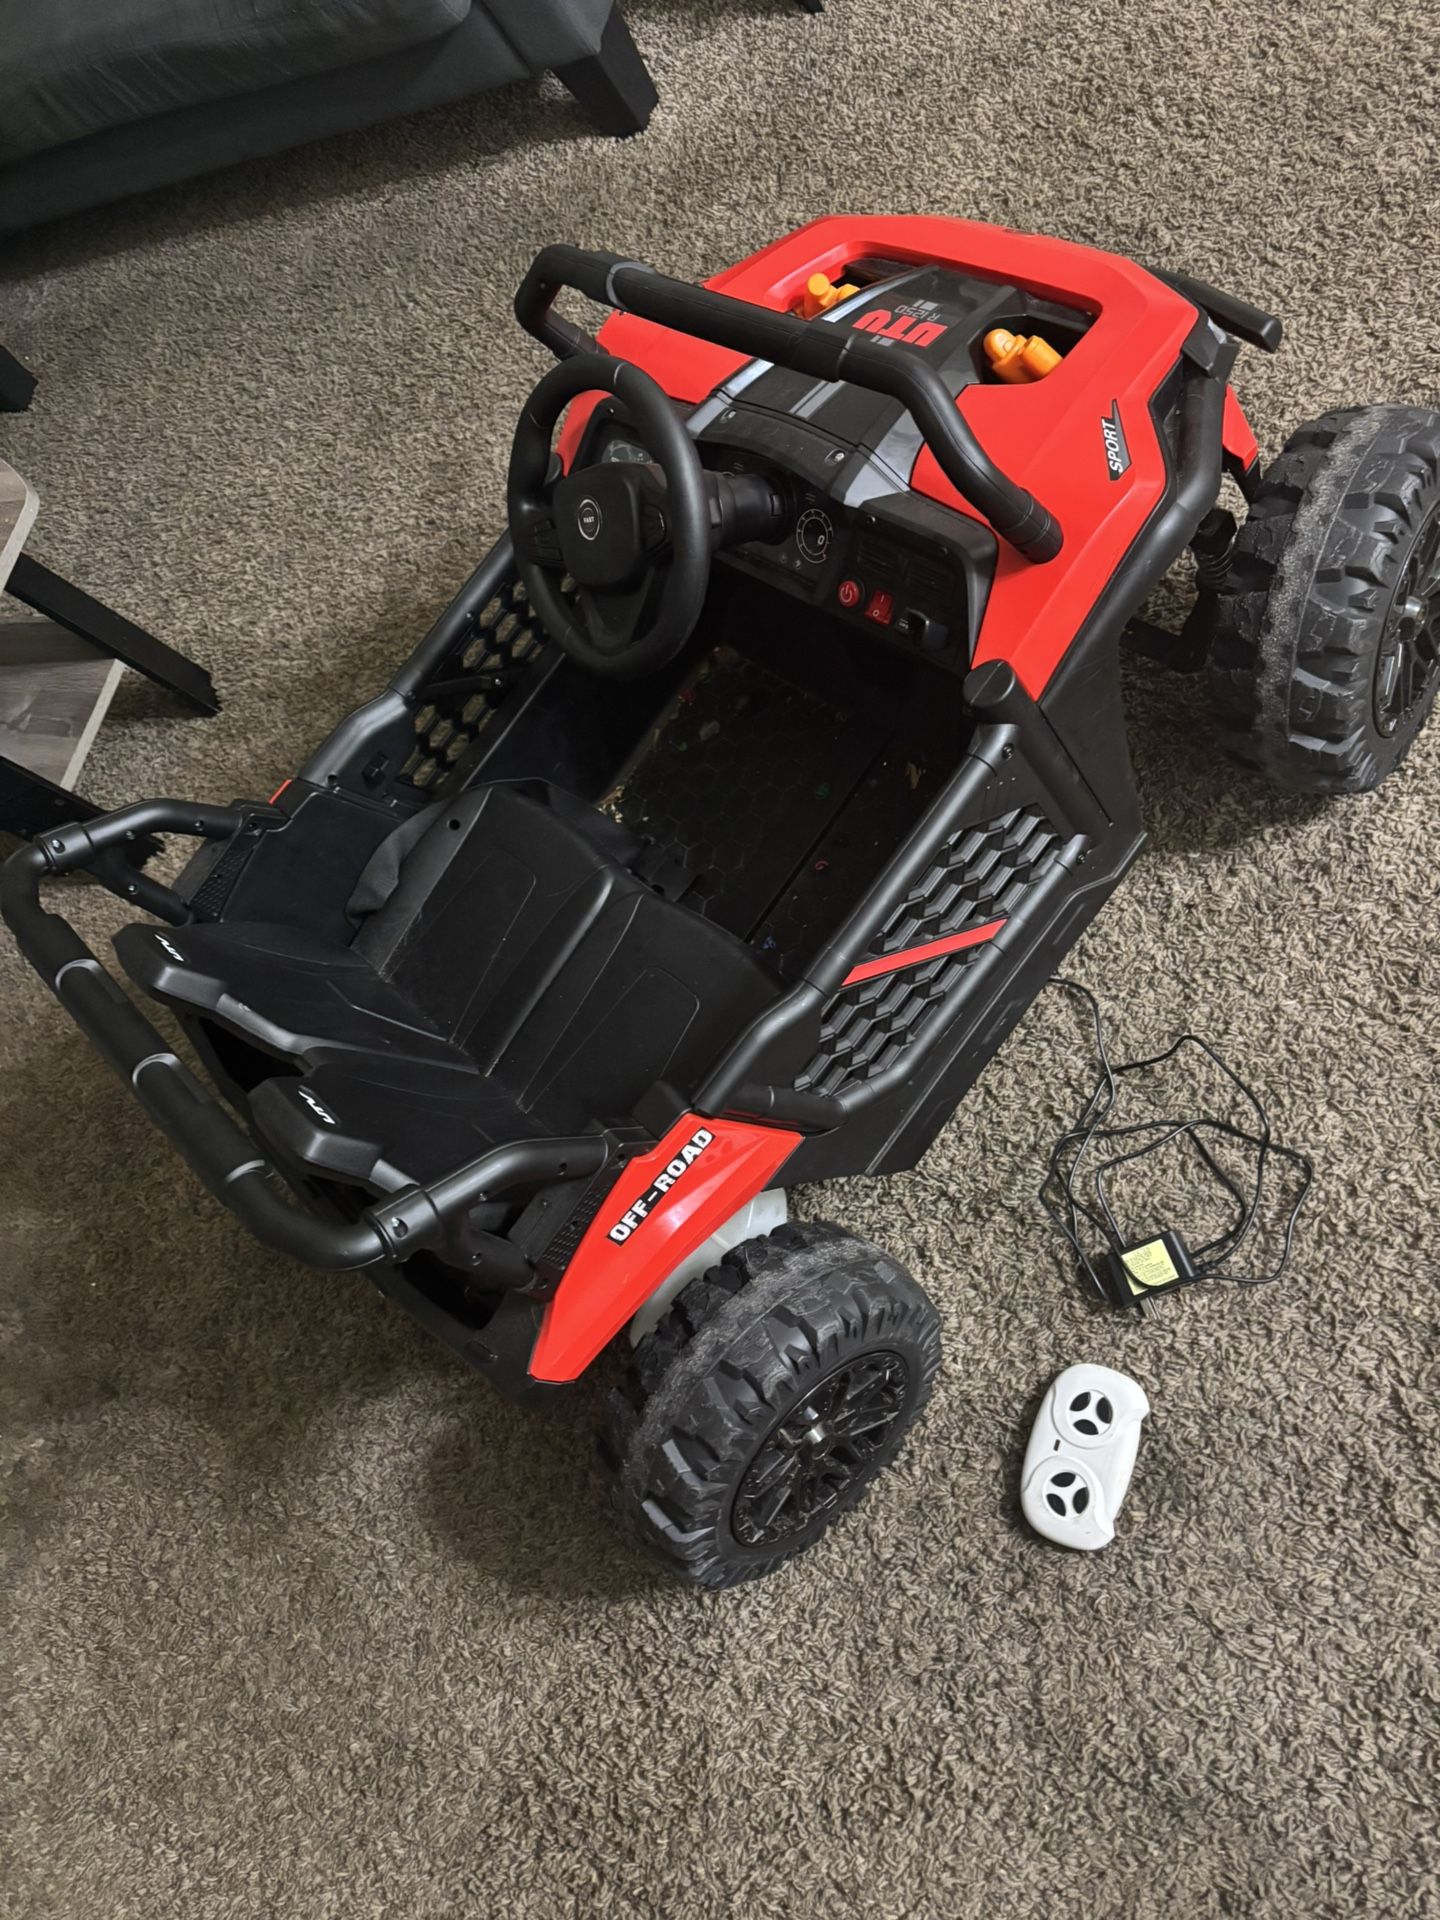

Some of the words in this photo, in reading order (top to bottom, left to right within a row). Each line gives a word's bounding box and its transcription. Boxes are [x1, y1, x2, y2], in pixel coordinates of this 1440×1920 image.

[852, 308, 948, 347] UTV
[895, 305, 929, 320] 1250
[927, 313, 942, 321] R
[1101, 418, 1124, 473] SPORT
[154, 933, 184, 962] UTV
[298, 1090, 336, 1125] UTV
[608, 1128, 713, 1242] OFF-ROAD
